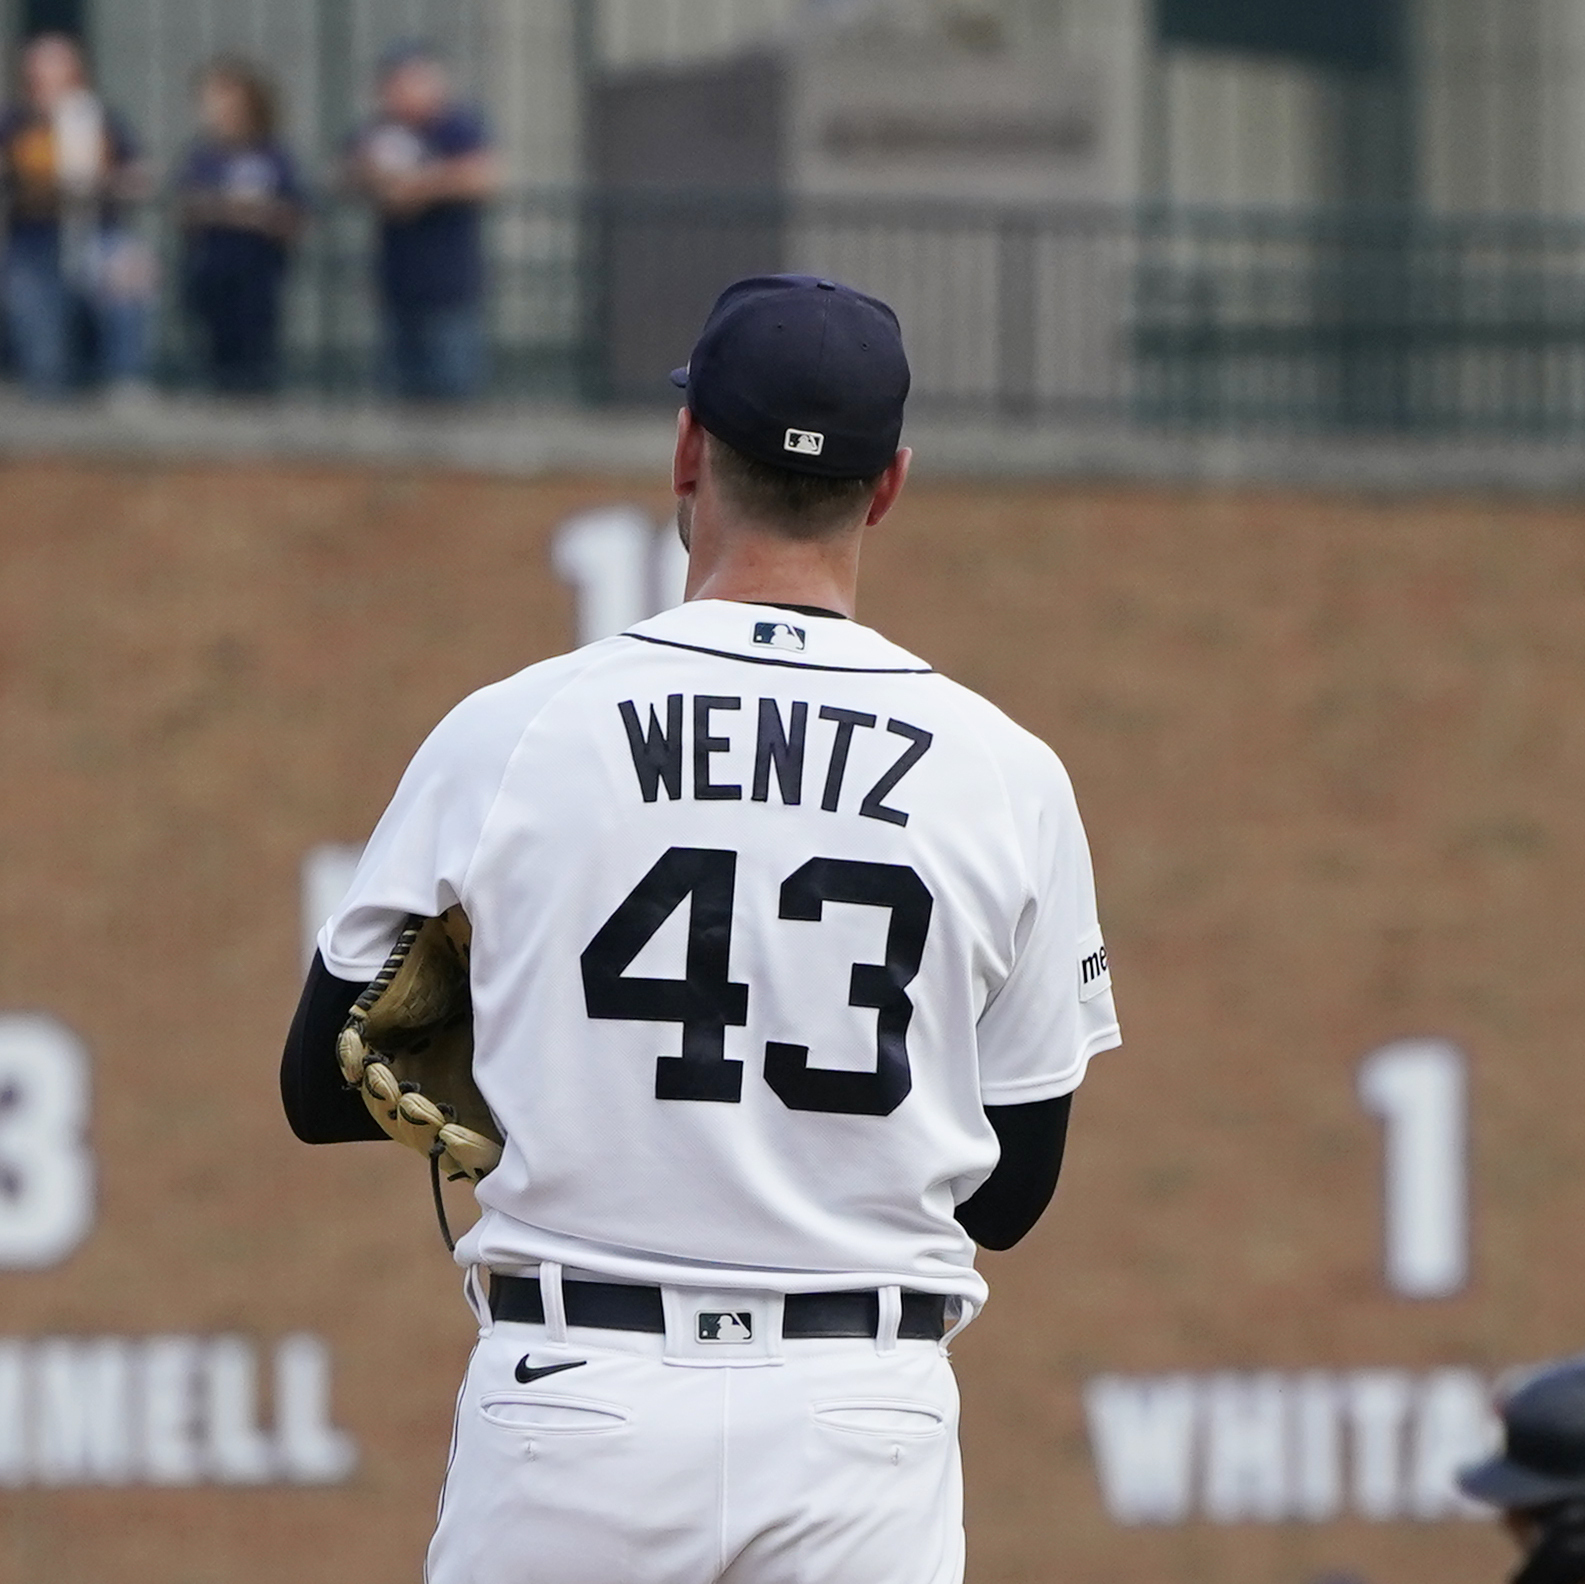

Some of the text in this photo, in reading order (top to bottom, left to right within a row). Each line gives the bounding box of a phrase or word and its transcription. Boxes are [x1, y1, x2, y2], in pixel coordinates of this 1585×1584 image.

[618, 694, 933, 827] WENTZ
[580, 847, 933, 1117] 43
[1359, 1041, 1467, 1297] 1
